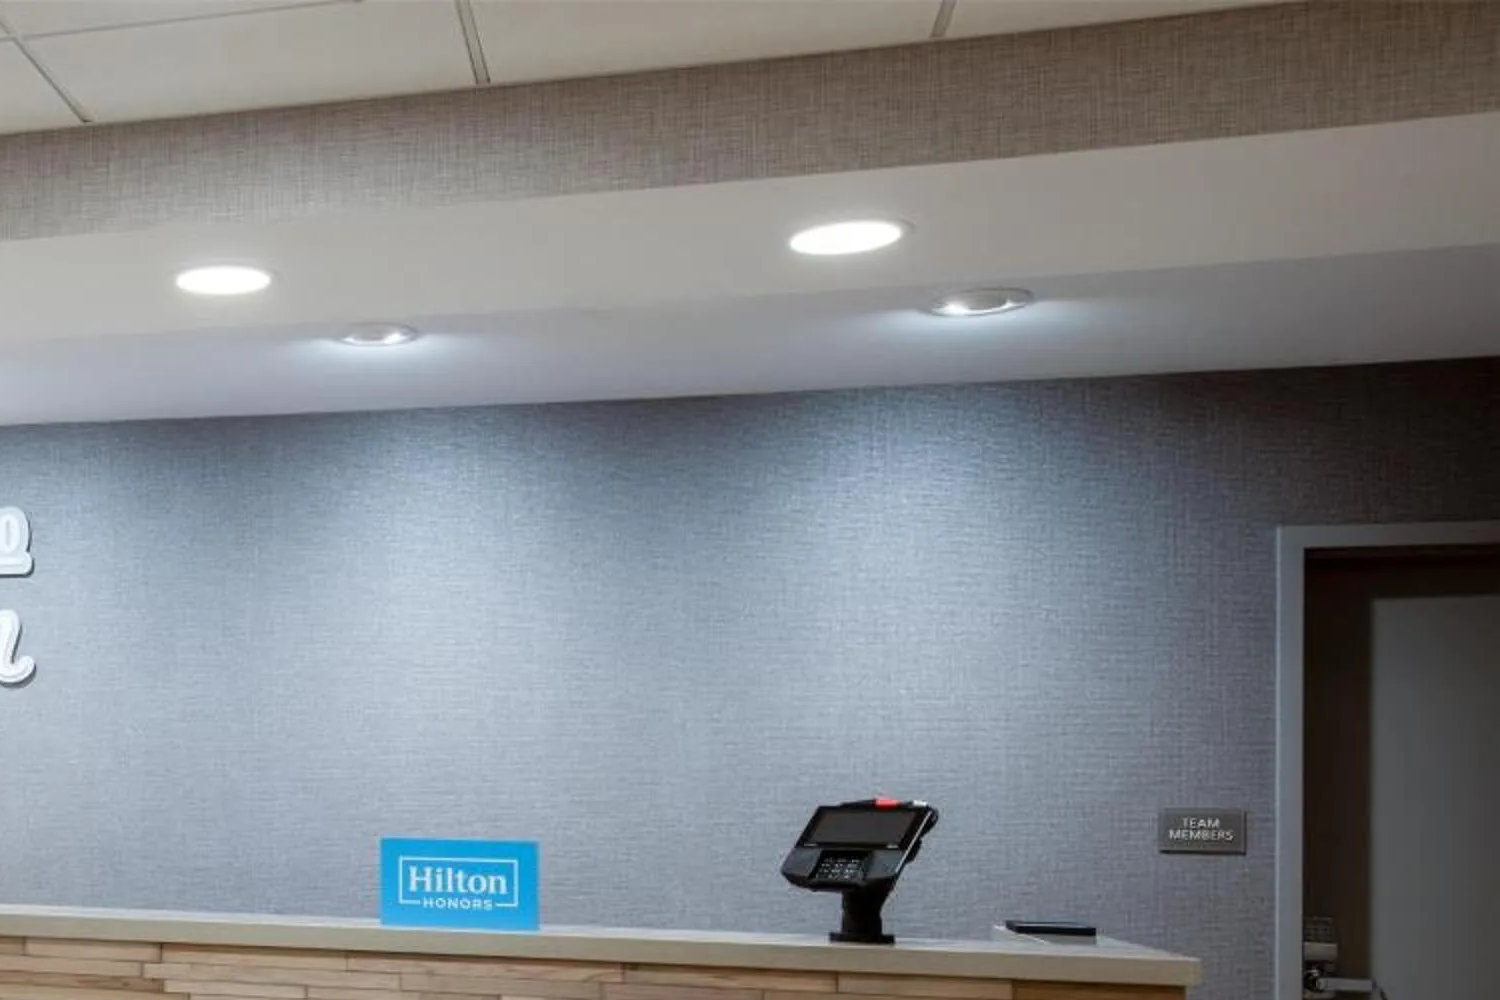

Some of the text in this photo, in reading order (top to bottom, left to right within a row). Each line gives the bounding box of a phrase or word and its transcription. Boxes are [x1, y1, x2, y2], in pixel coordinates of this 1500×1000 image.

[1182, 818, 1220, 829] TEAM
[1168, 829, 1234, 841] MEMBERS
[408, 865, 508, 895] Hilton
[423, 897, 493, 911] HONORS
